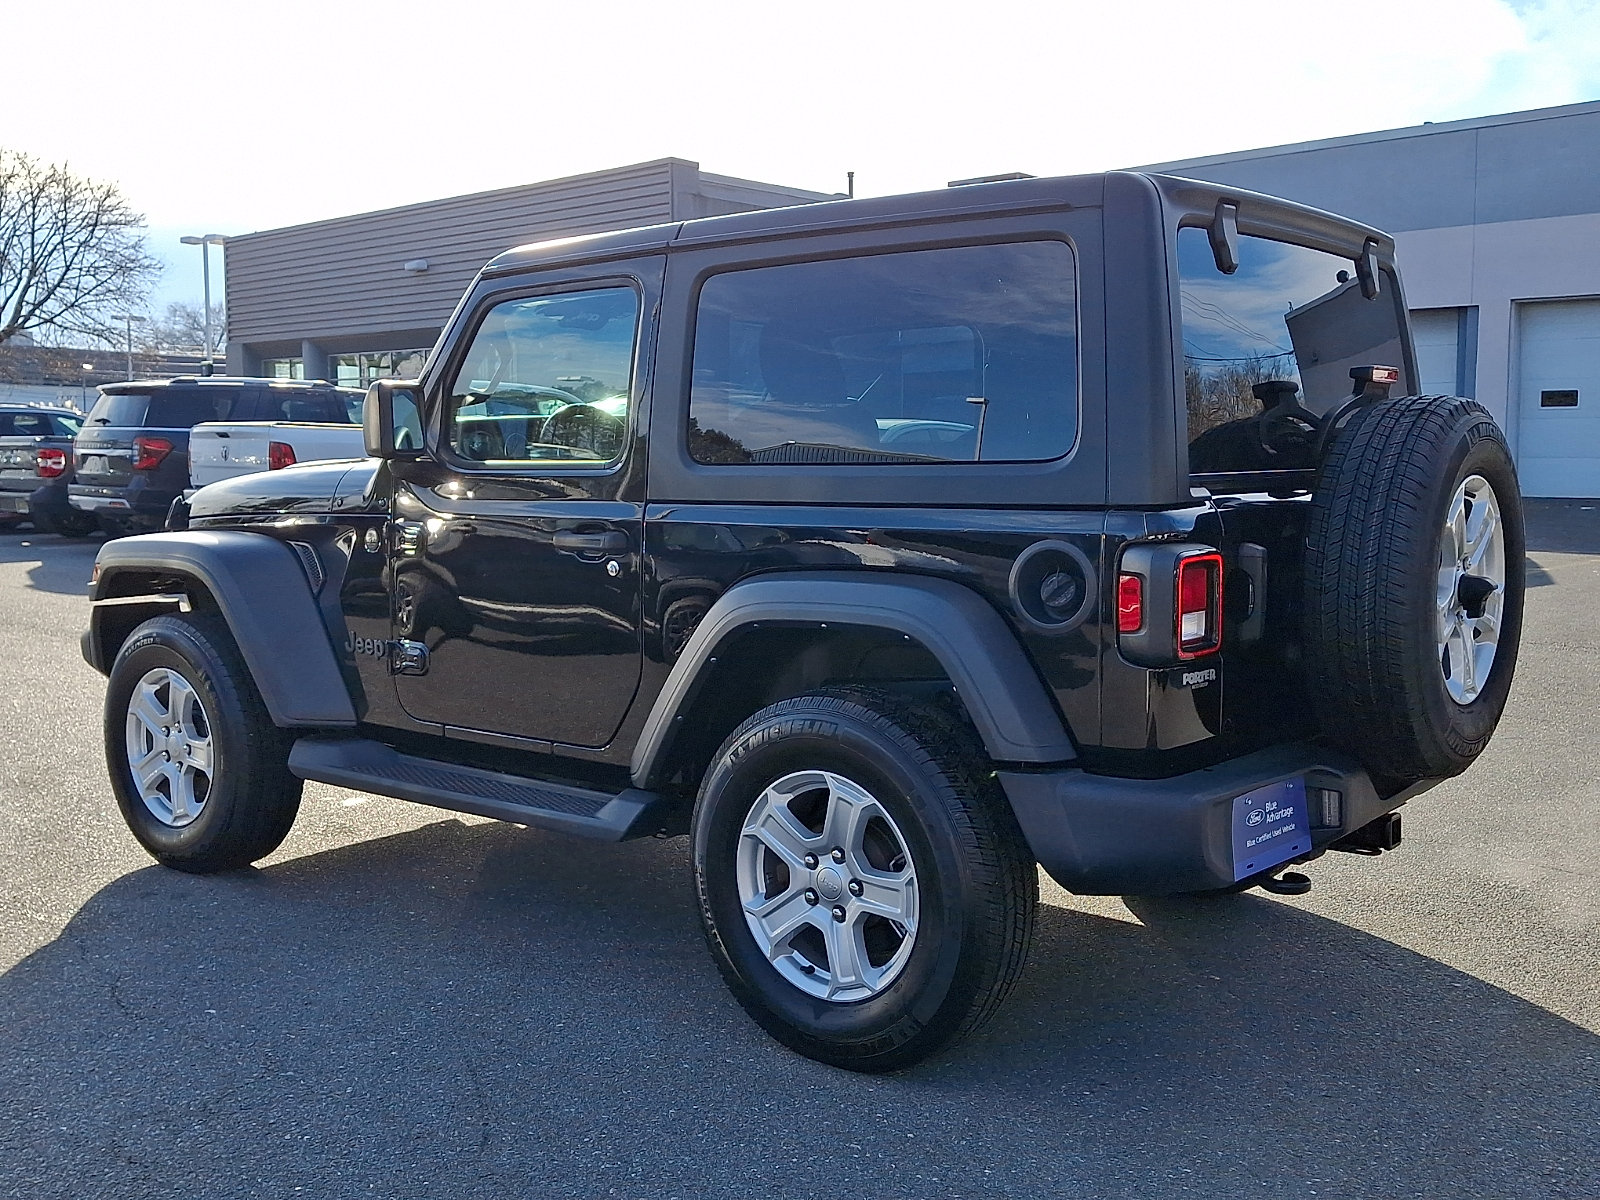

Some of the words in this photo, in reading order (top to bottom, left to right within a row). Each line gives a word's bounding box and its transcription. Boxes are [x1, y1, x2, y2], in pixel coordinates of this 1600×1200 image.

[345, 631, 385, 660] Jeep
[1182, 668, 1216, 685] PORTER
[1265, 801, 1277, 812] Blue
[1248, 811, 1263, 824] Ford
[1266, 807, 1294, 823] Advantage
[1255, 831, 1272, 844] Certified
[1271, 827, 1282, 837] Used
[1281, 822, 1296, 833] Vehicle
